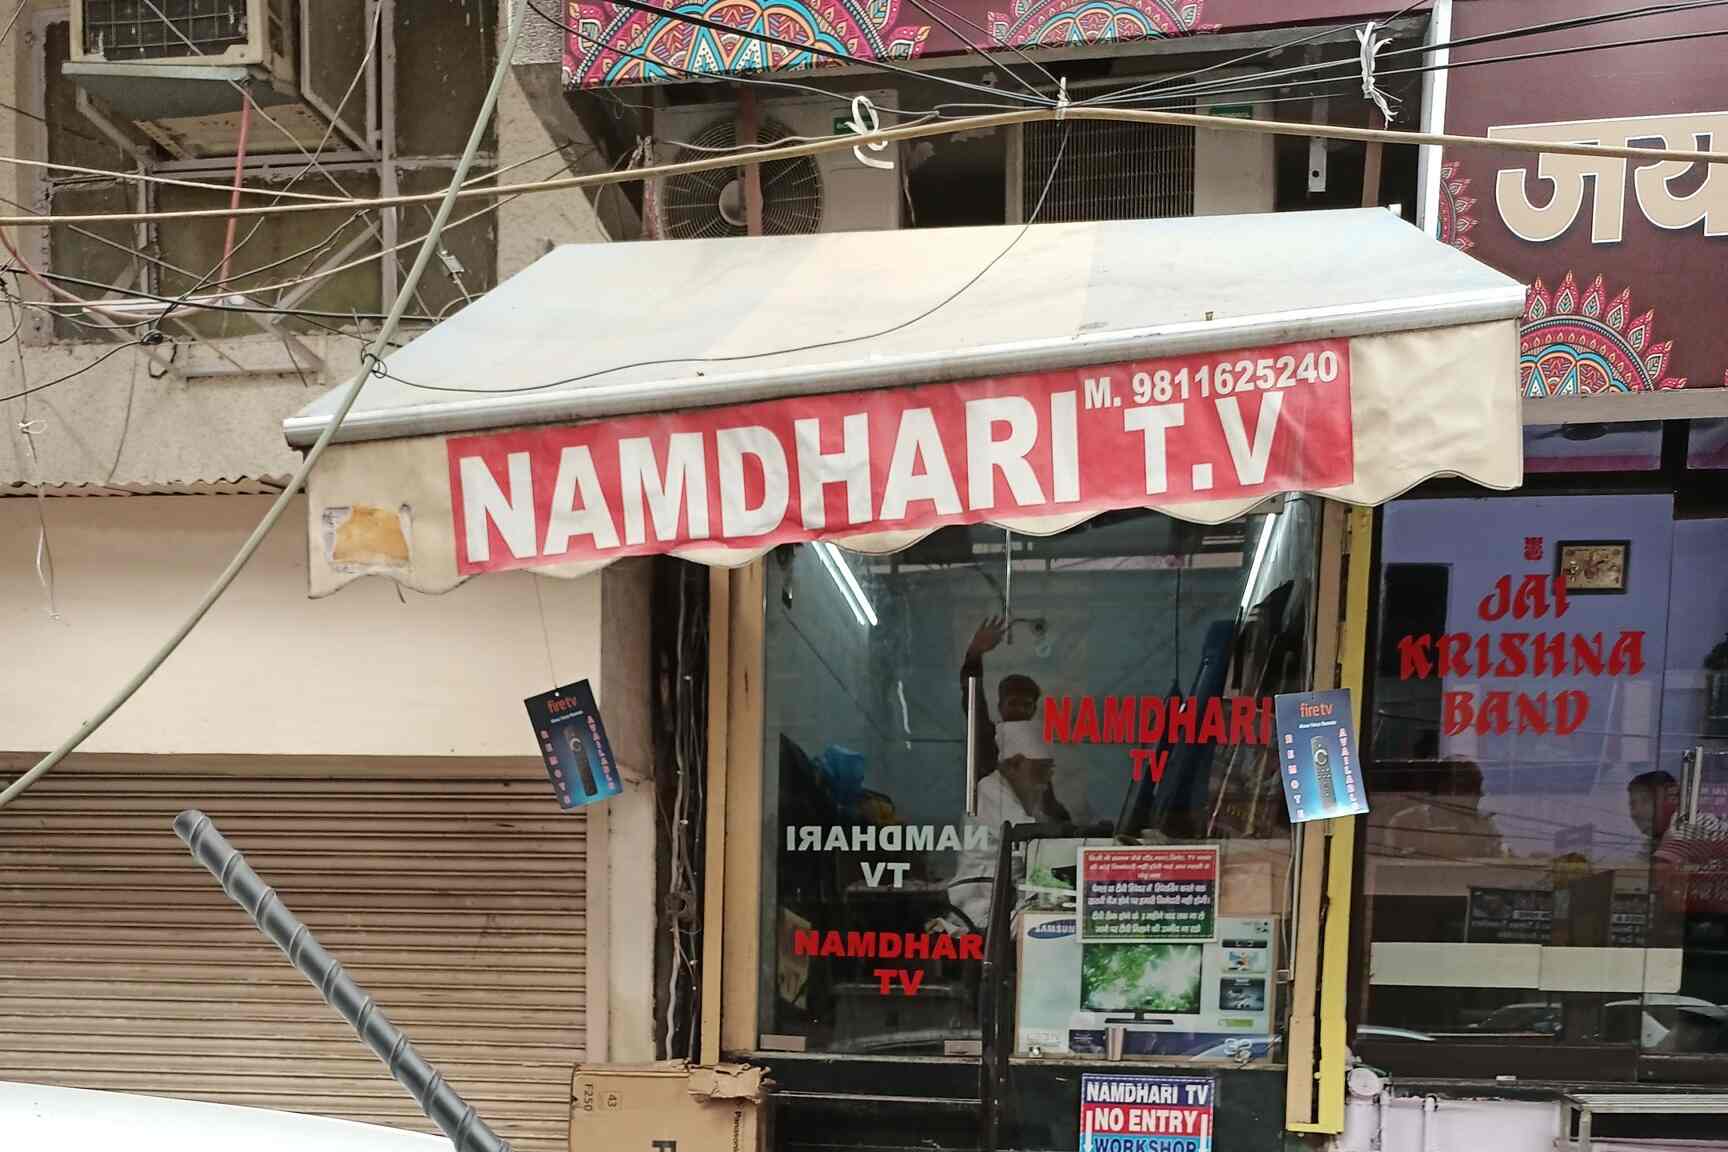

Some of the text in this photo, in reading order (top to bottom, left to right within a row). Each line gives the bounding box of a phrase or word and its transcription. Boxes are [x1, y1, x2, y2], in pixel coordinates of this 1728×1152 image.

[1487, 112, 1728, 243] जय
[1083, 351, 1339, 410] M. 9811625240
[459, 391, 1285, 563] NAMDHARI T.V
[1477, 573, 1570, 622] JAI
[1397, 630, 1646, 680] KRISHNA
[1042, 695, 1275, 745] NAMDHARI
[1442, 689, 1590, 736] BAND
[1129, 748, 1169, 783] TV
[794, 929, 985, 961] NAMDHAR
[1034, 923, 1076, 934] SAMSUN
[873, 968, 925, 996] TV
[1086, 1081, 1209, 1105] NAMDHARI TV
[1094, 1107, 1199, 1133] NO ENTRY
